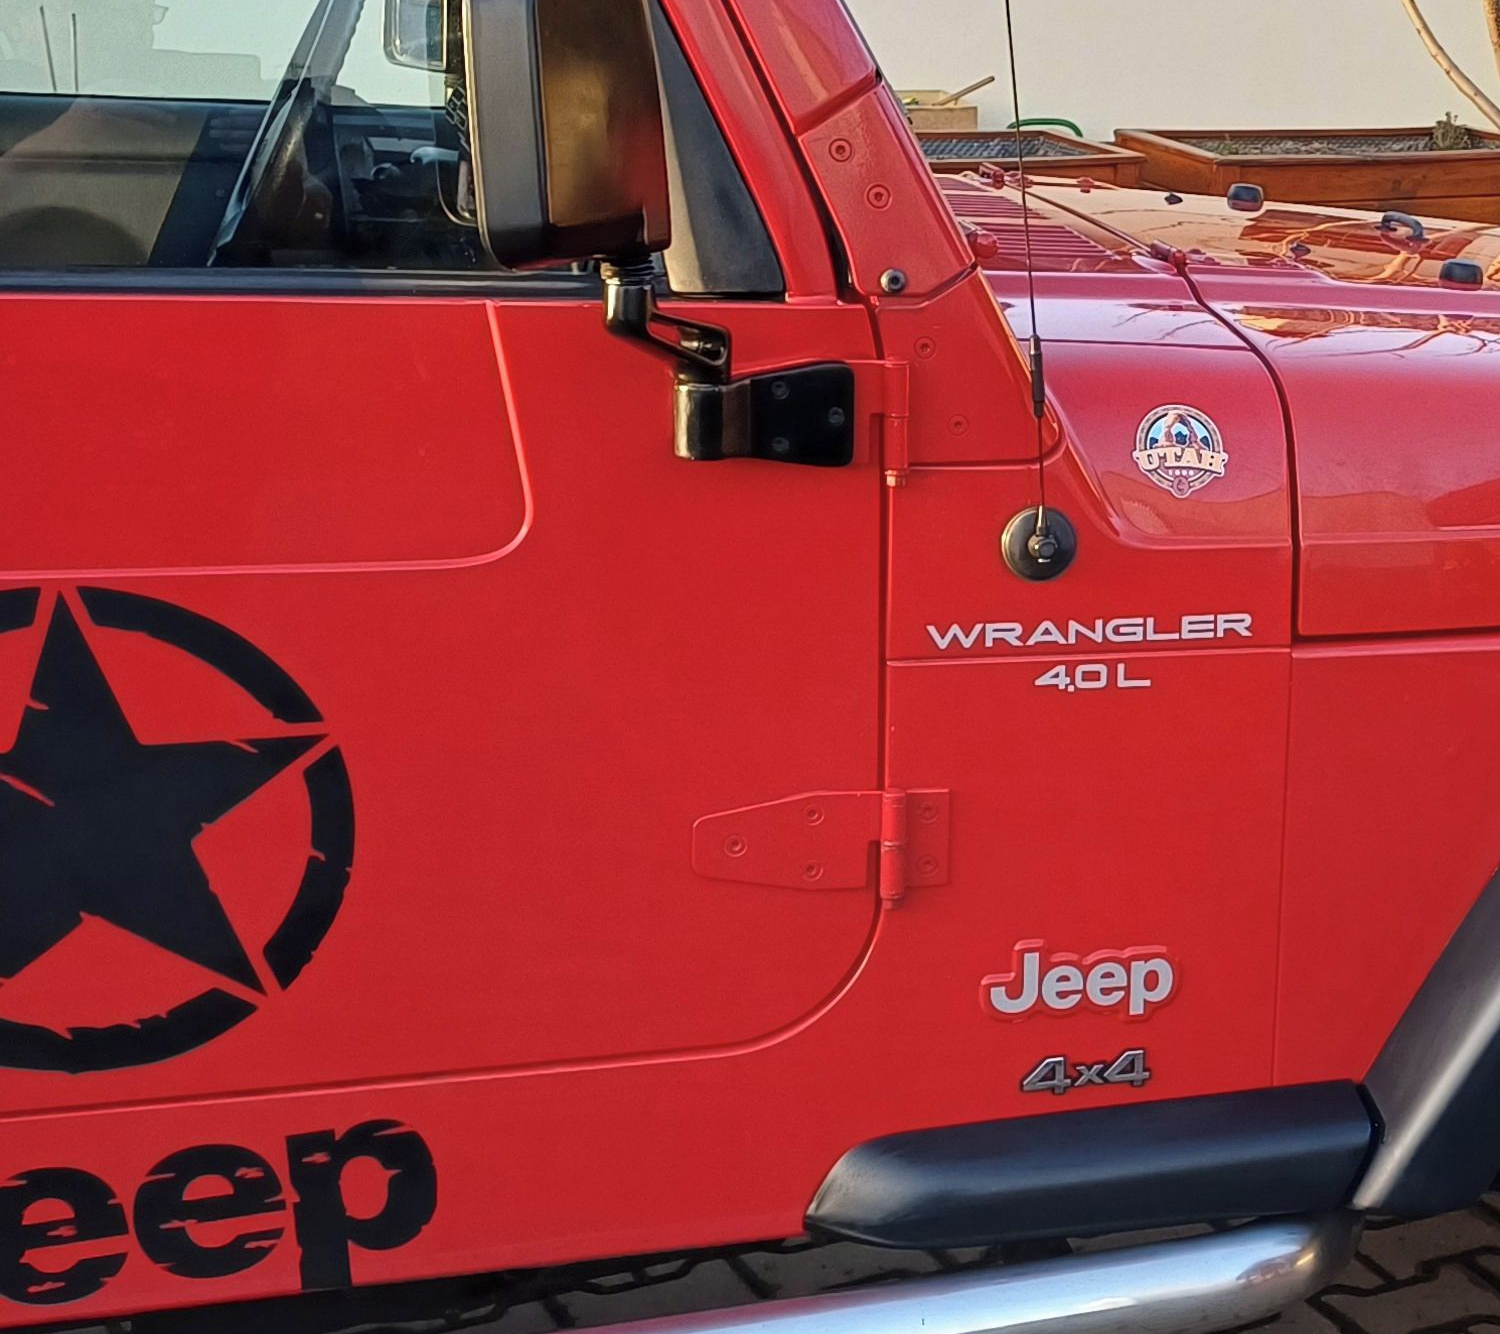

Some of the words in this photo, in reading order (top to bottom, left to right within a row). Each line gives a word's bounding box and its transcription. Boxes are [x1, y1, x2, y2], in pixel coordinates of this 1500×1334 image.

[1138, 446, 1222, 475] UTAH
[926, 613, 1253, 649] WRANGLER
[989, 951, 1174, 1016] Jeep
[1021, 1048, 1151, 1095] 4x4
